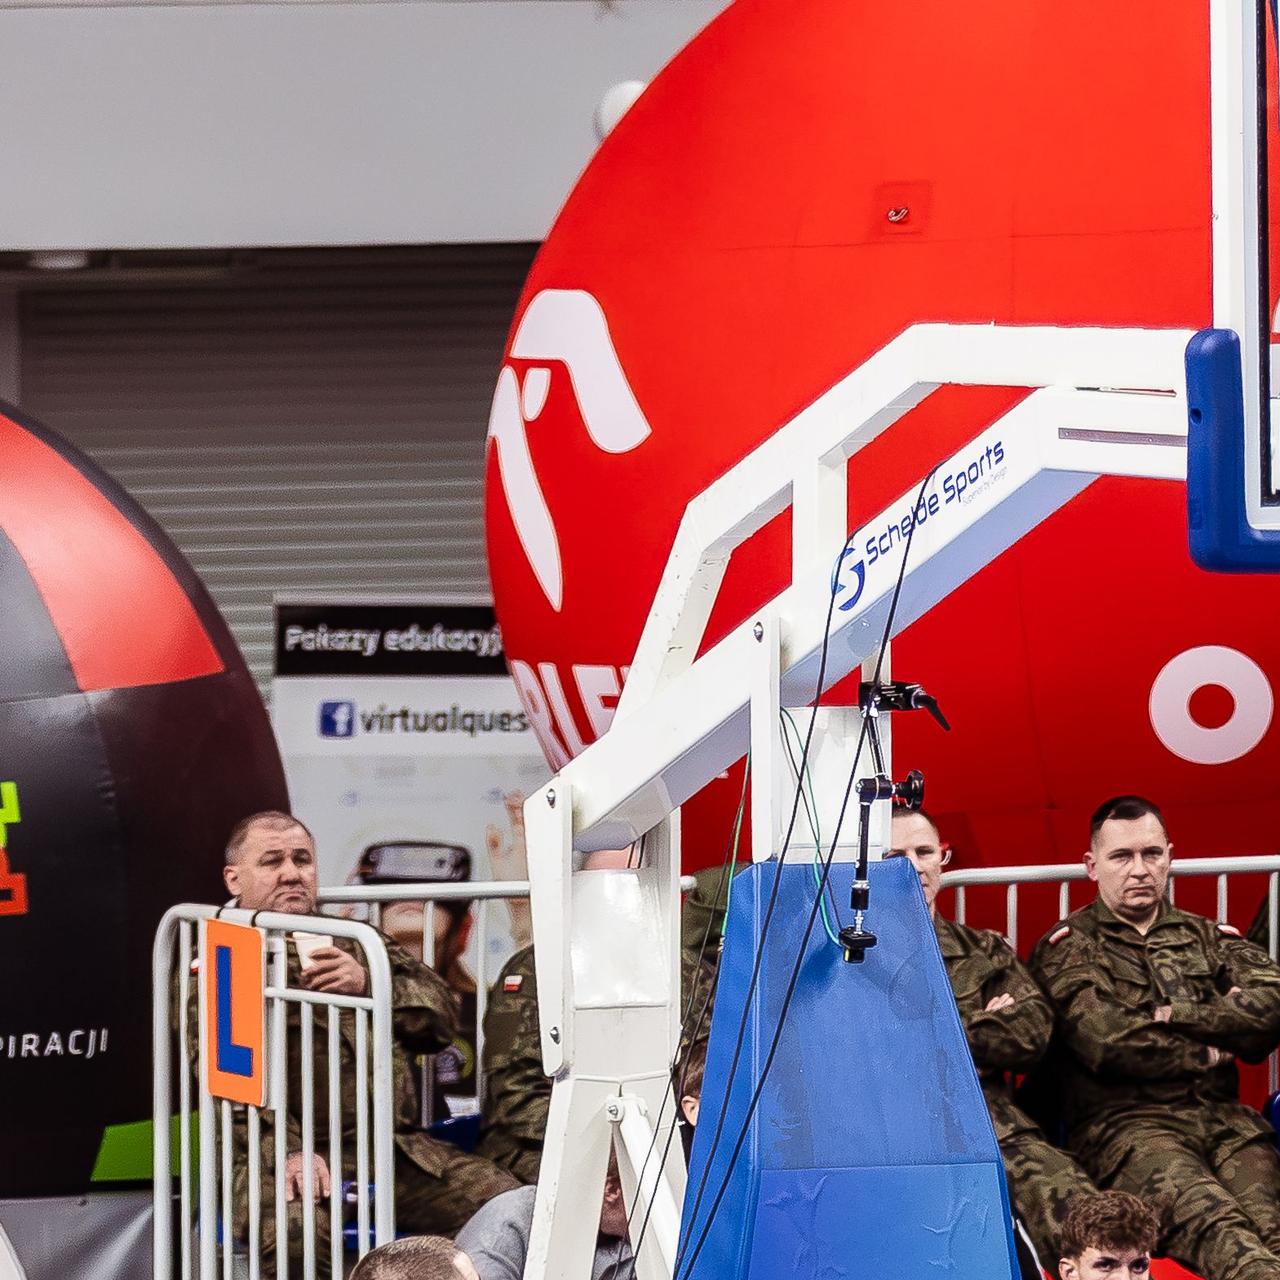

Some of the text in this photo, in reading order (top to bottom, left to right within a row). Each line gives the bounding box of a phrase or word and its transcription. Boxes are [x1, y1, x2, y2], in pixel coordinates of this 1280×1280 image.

[866, 441, 1005, 566] Schelde Sports
[0, 1027, 109, 1059] IRACJI
[215, 945, 254, 1078] L
